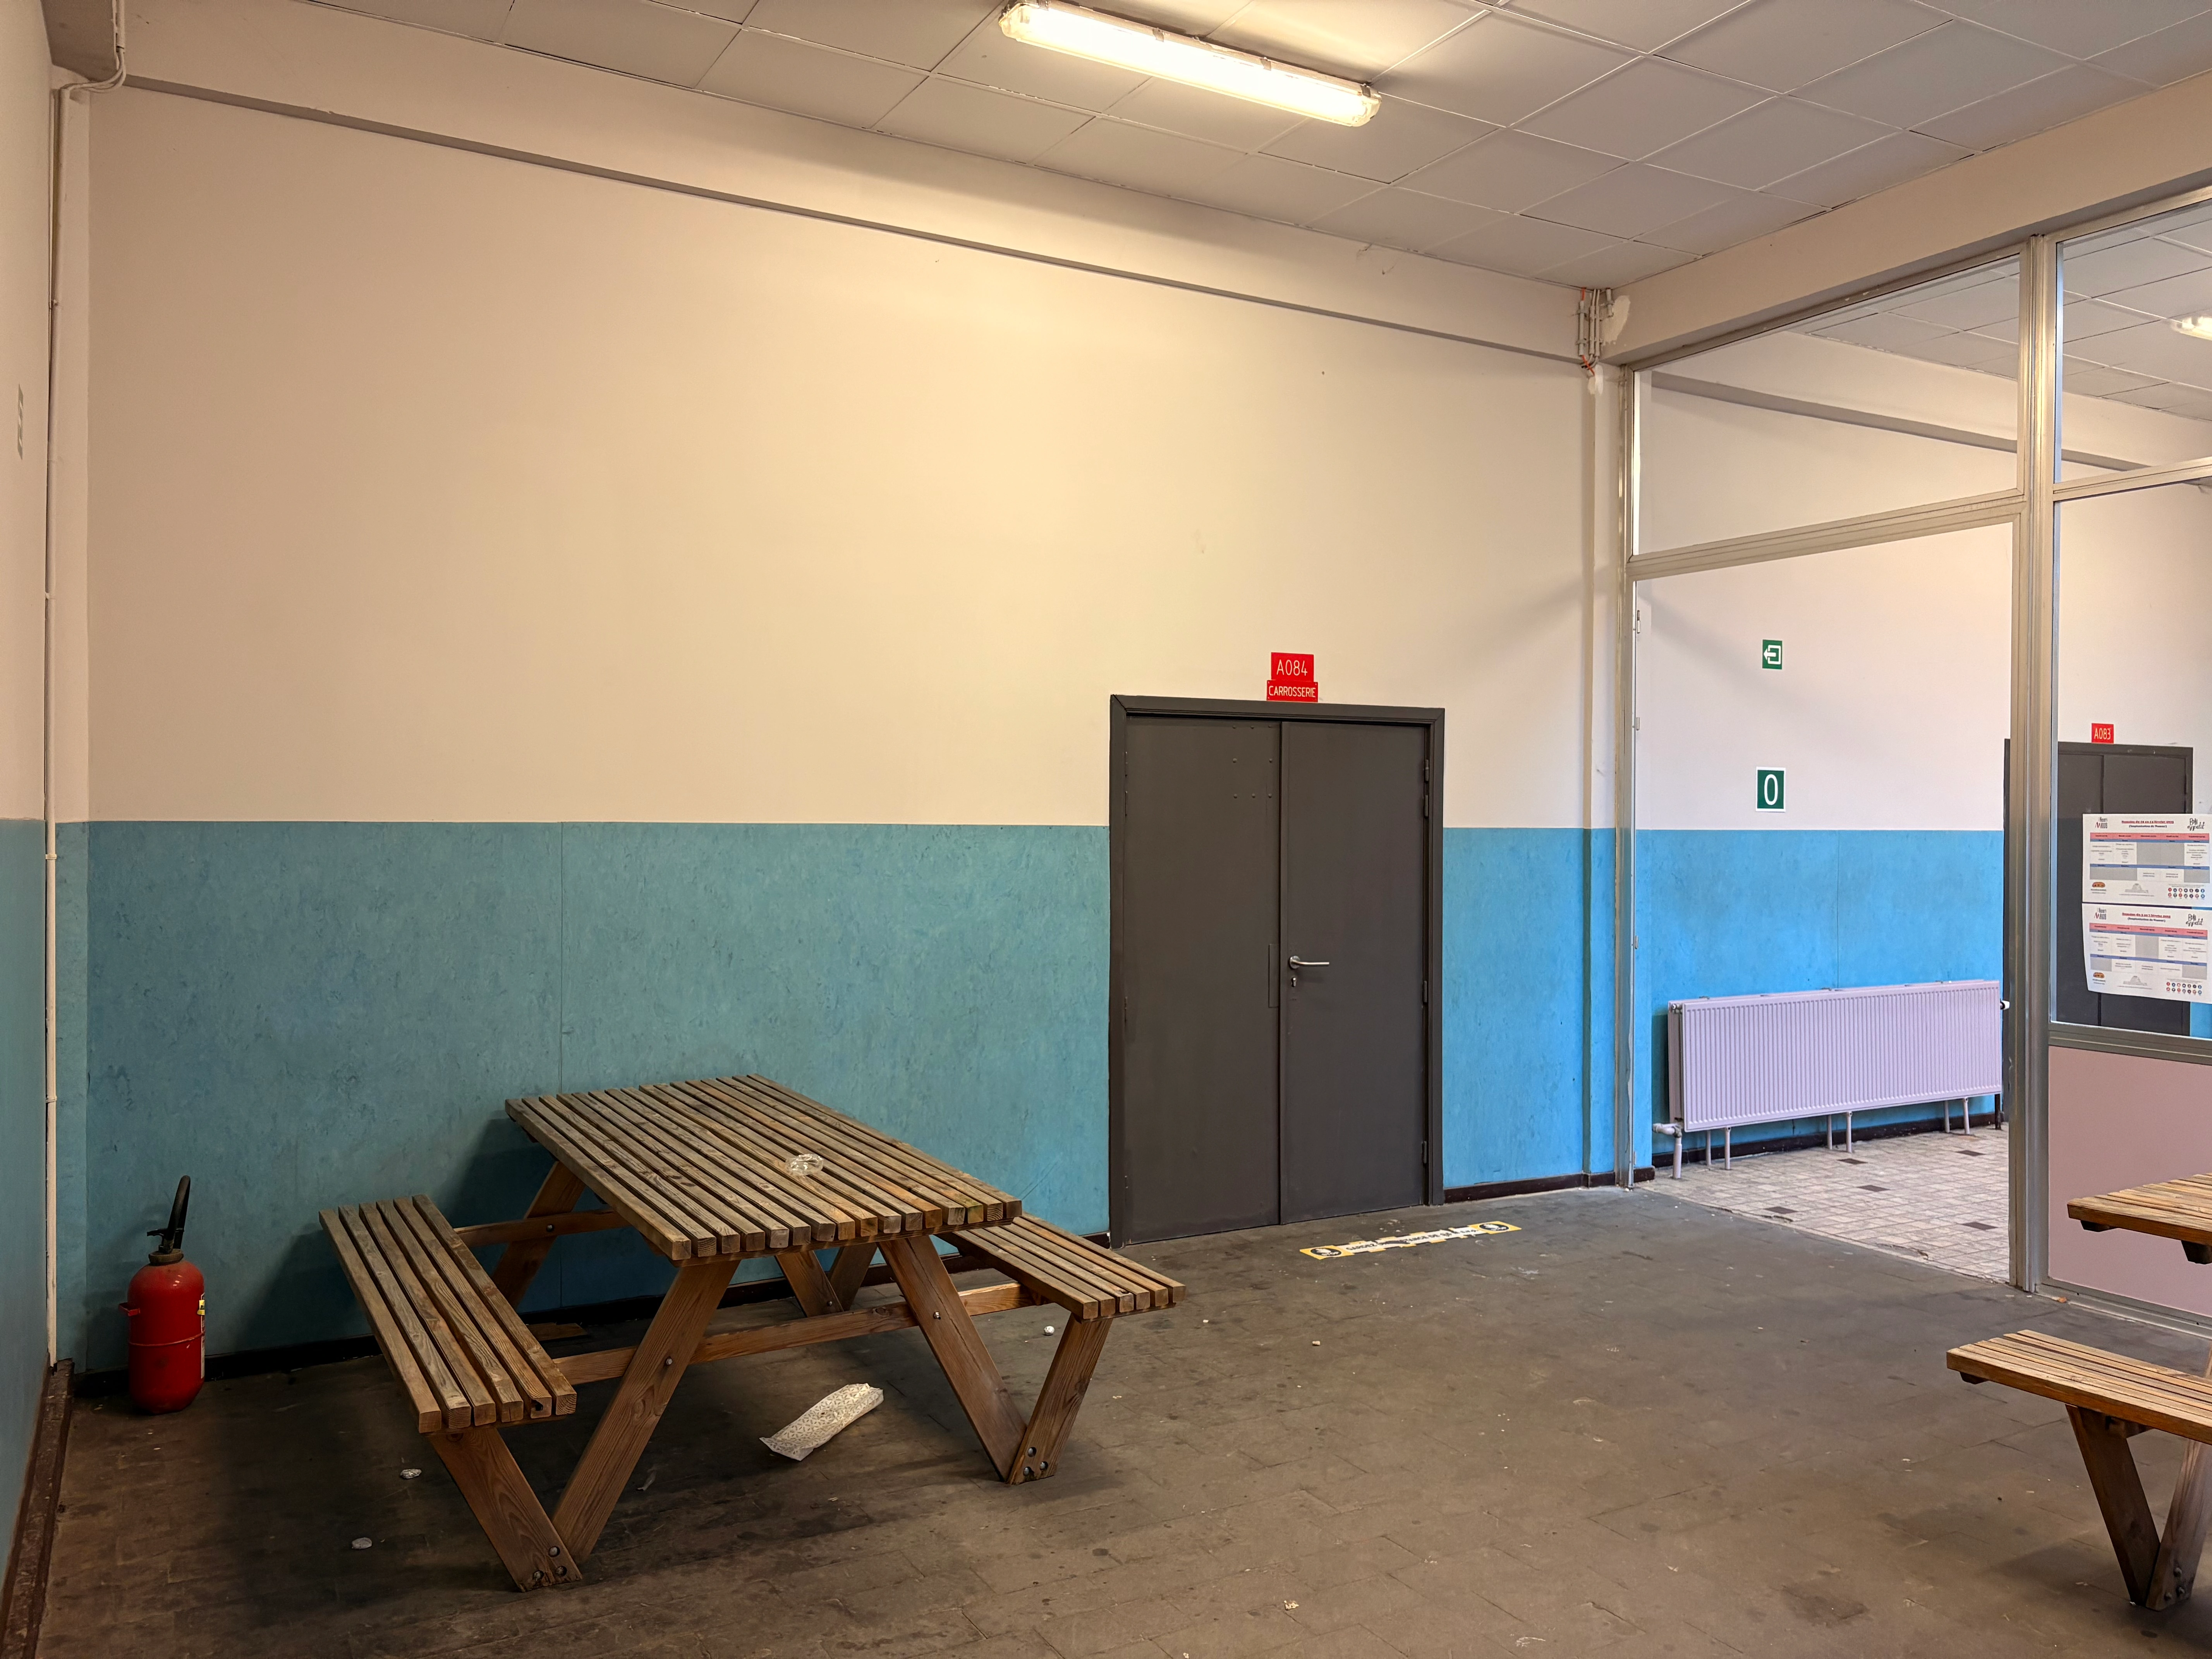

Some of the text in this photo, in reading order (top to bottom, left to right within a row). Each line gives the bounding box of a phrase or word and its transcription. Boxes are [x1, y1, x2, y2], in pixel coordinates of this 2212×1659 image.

[1276, 659, 1308, 676] A084
[1269, 685, 1316, 698] CARROSSERIE
[2094, 728, 2111, 740] A083
